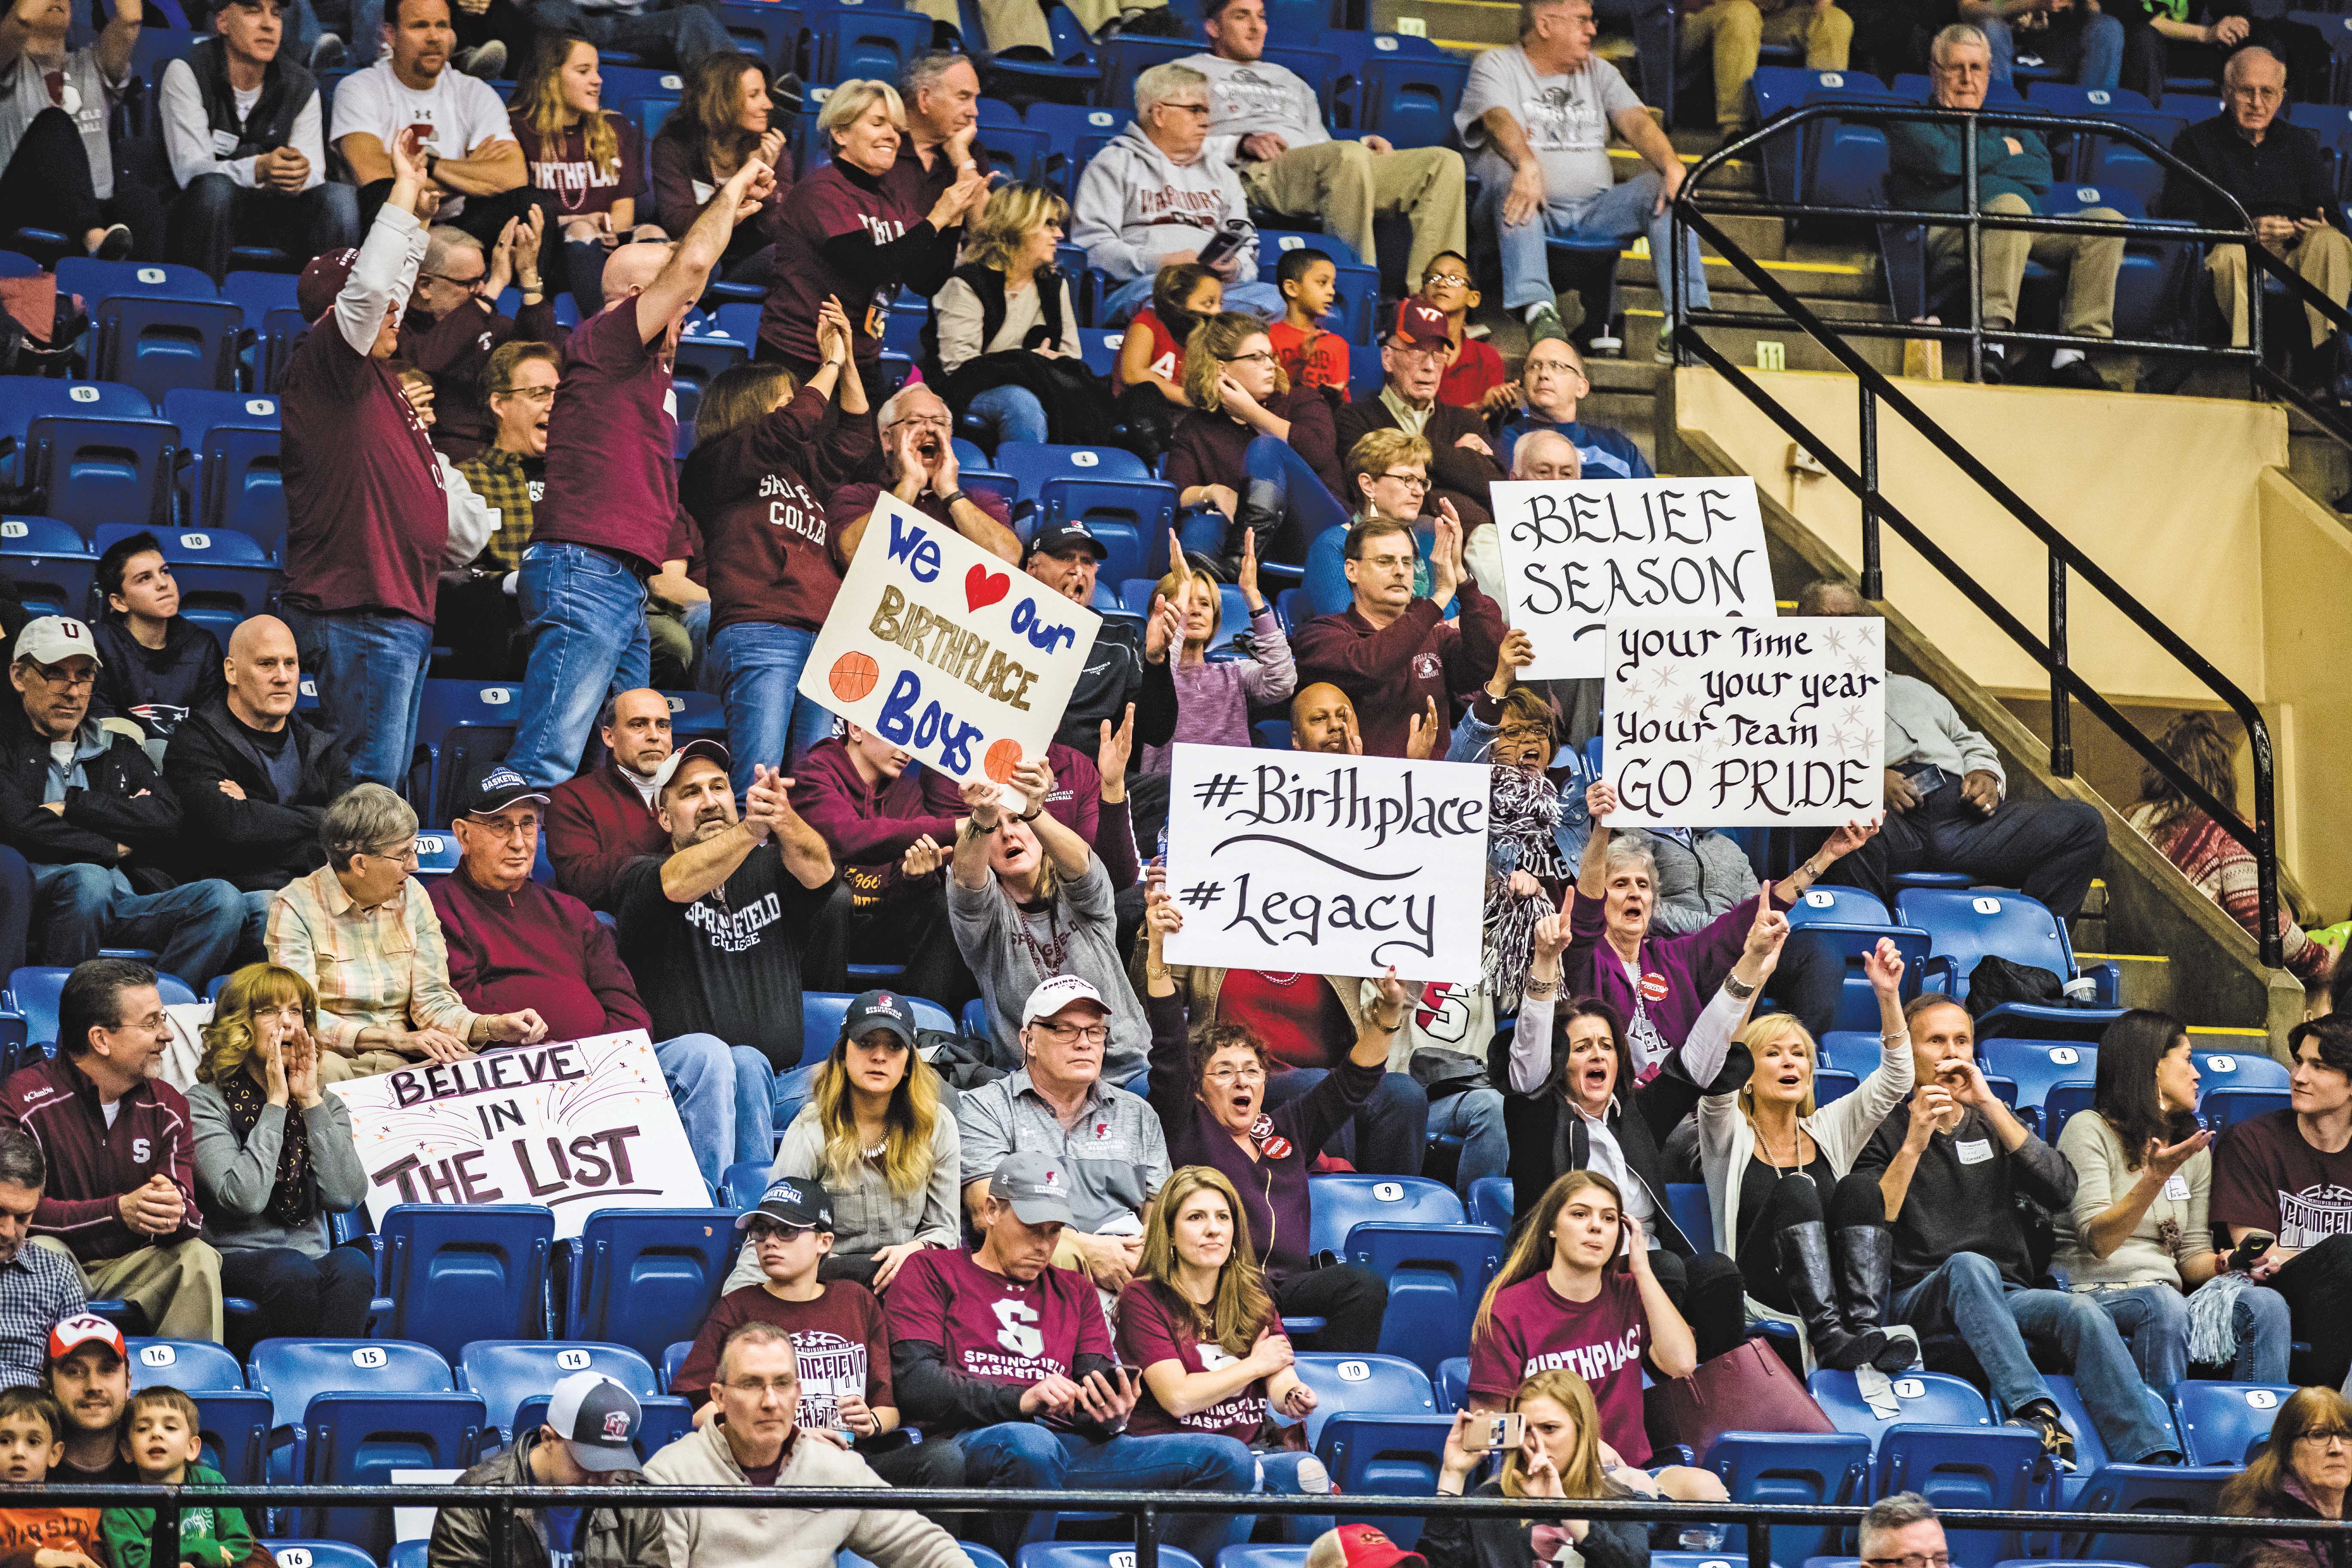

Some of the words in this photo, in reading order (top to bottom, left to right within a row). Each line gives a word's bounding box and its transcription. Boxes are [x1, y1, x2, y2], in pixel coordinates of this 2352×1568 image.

[1415, 307, 1443, 322] VT
[79, 389, 92, 399] 10
[257, 403, 264, 411] 9
[1510, 489, 1737, 553] BELIEF
[6, 525, 18, 535] 11
[189, 536, 202, 545] 10
[890, 513, 941, 583] We
[1520, 549, 1756, 616] SEASON
[60, 623, 79, 639] U
[1731, 626, 1813, 658] Time
[869, 585, 1039, 712] BIRTHPLACE
[1418, 669, 1439, 679] ALUMNI
[491, 691, 498, 701] 9
[1790, 673, 1880, 723] year
[1725, 714, 1818, 748] Team
[481, 775, 526, 791] BASKETBALL
[1617, 758, 1692, 818] GO
[1709, 758, 1873, 816] PRIDE
[1193, 764, 1485, 850] #Birthplace
[1816, 894, 1823, 903] 2
[1983, 901, 1989, 910] 1
[1180, 873, 1436, 968] #Legacy
[2061, 1051, 2067, 1061] 4
[2217, 1059, 2225, 1069] 3
[390, 1044, 585, 1109] BELIEVE
[28, 1087, 54, 1099] Columbia
[477, 1097, 526, 1141] IN
[133, 1139, 150, 1164] S
[371, 1148, 504, 1204] THE
[514, 1126, 641, 1196] LIST
[1384, 1191, 1390, 1201] 9
[69, 1319, 106, 1329] VT
[991, 1298, 1045, 1359] S
[150, 1350, 165, 1362] 16
[361, 1352, 377, 1363] 15
[1525, 1324, 1641, 1381] BIRTHPLAC
[566, 1354, 581, 1366] 14
[968, 1364, 1052, 1380] BASKETB
[1347, 1365, 1360, 1376] 10
[1904, 1383, 1911, 1394] 7
[2257, 1393, 2265, 1404] 5
[287, 1553, 303, 1565] 16
[1118, 1556, 1134, 1568] 12
